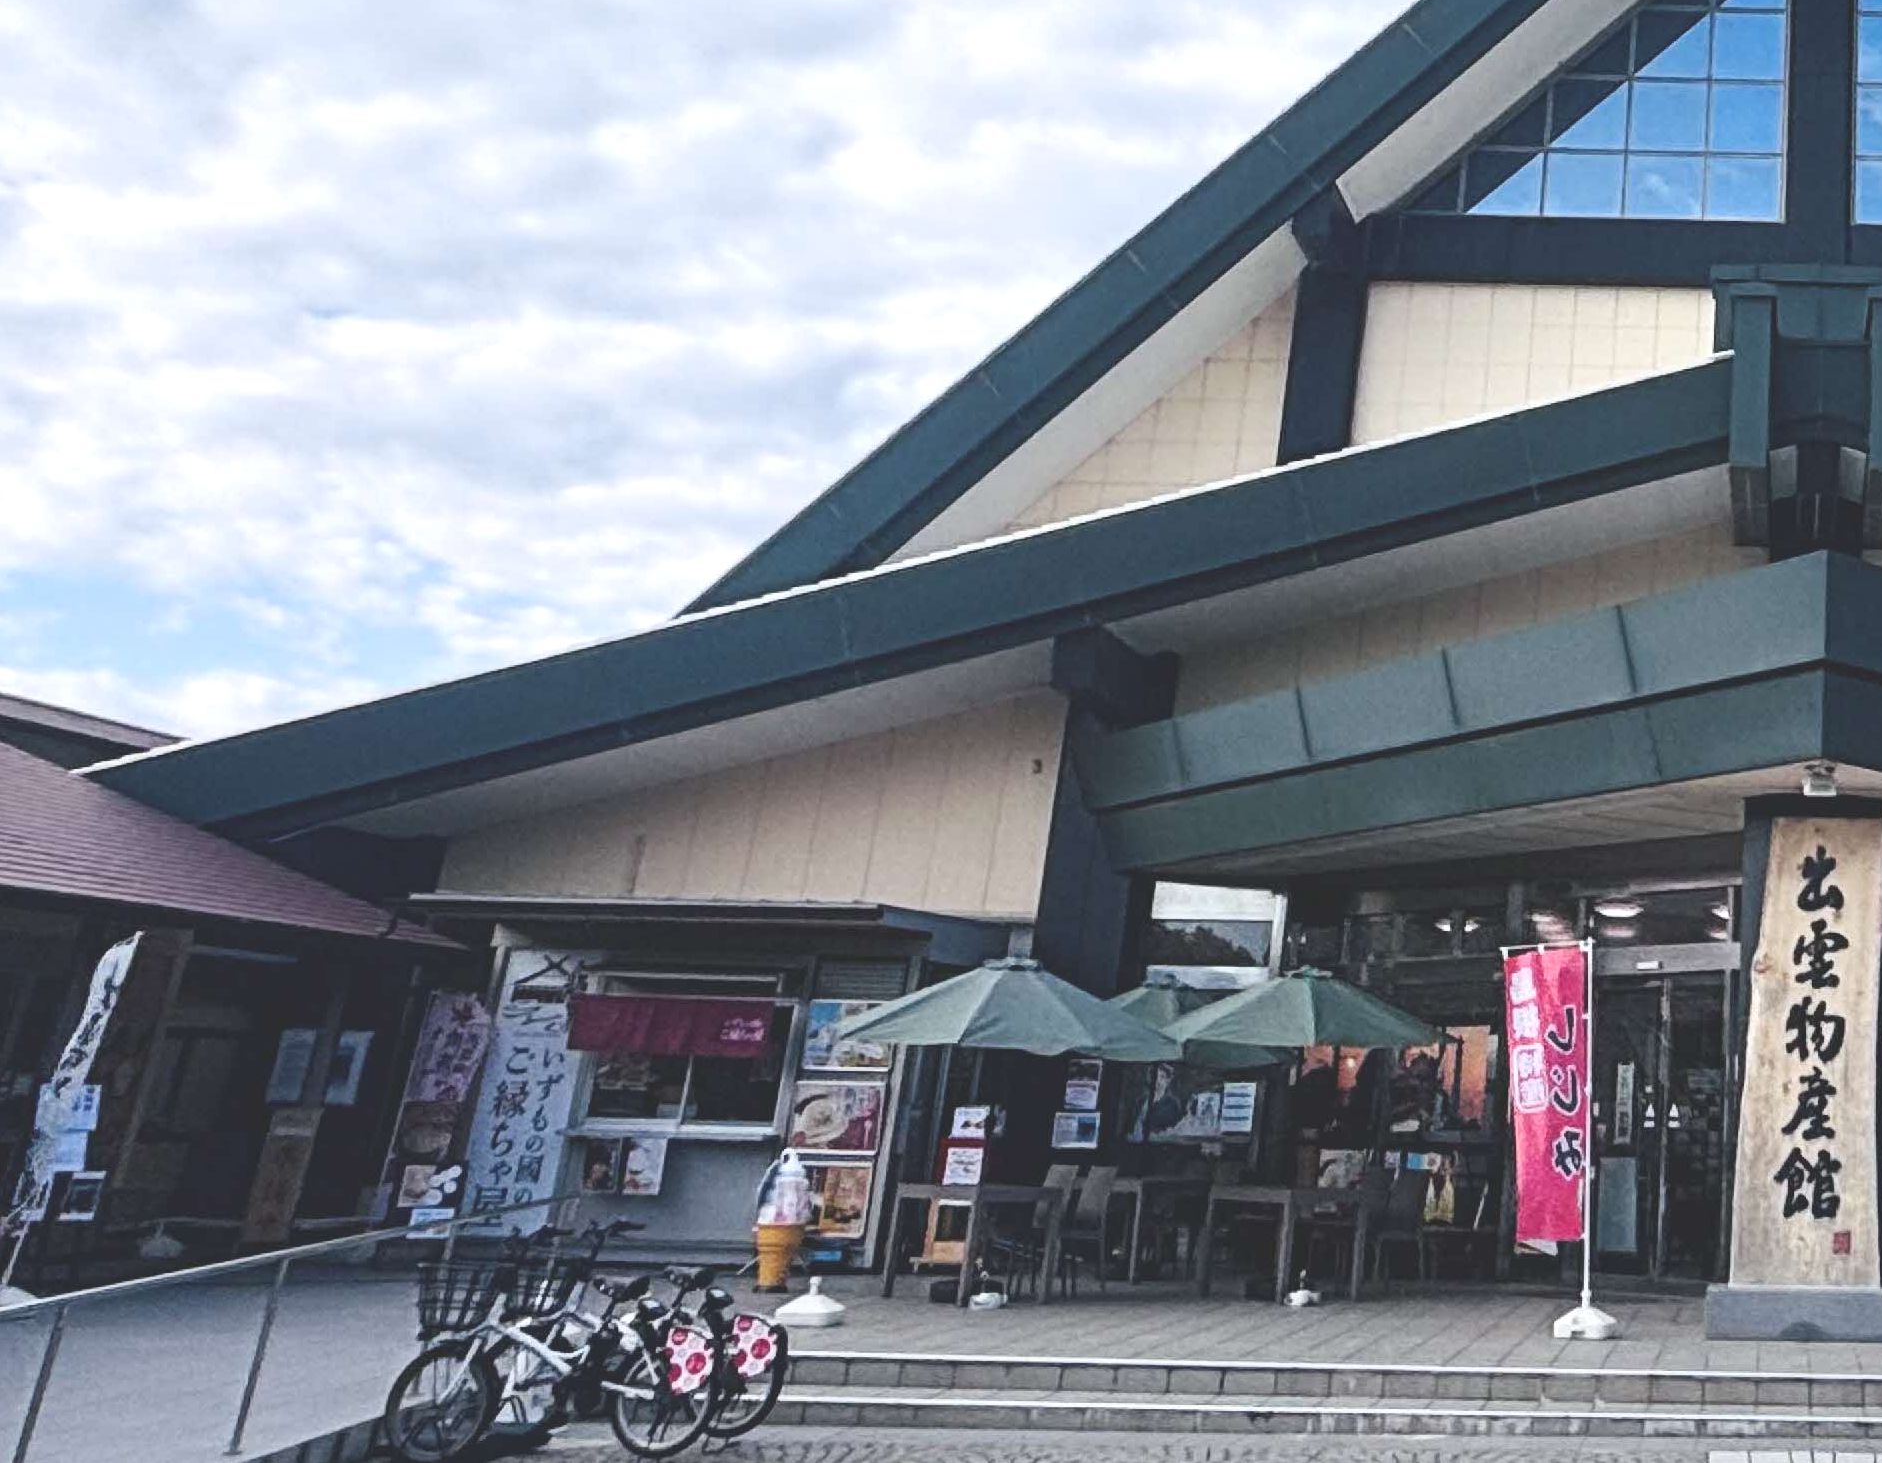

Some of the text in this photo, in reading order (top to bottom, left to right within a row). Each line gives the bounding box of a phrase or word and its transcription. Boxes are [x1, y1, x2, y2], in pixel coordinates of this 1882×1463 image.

[1773, 845, 1850, 1220] 出雲物産館
